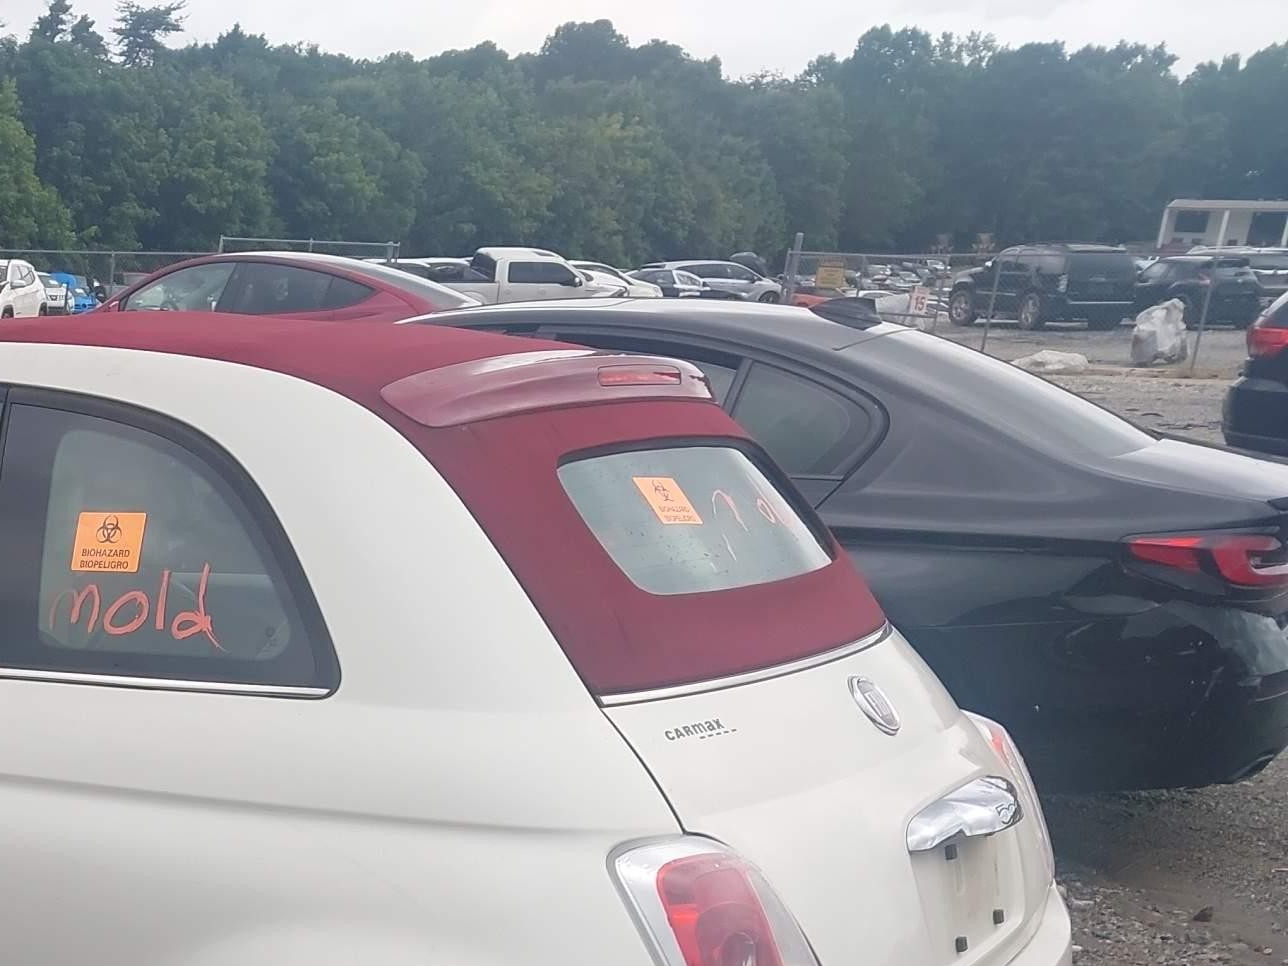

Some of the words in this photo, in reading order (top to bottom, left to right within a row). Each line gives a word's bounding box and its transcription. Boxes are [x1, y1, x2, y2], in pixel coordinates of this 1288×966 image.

[914, 295, 926, 312] 15
[81, 548, 130, 558] BIOHAZARD
[79, 560, 129, 570] BIOPELIGRO
